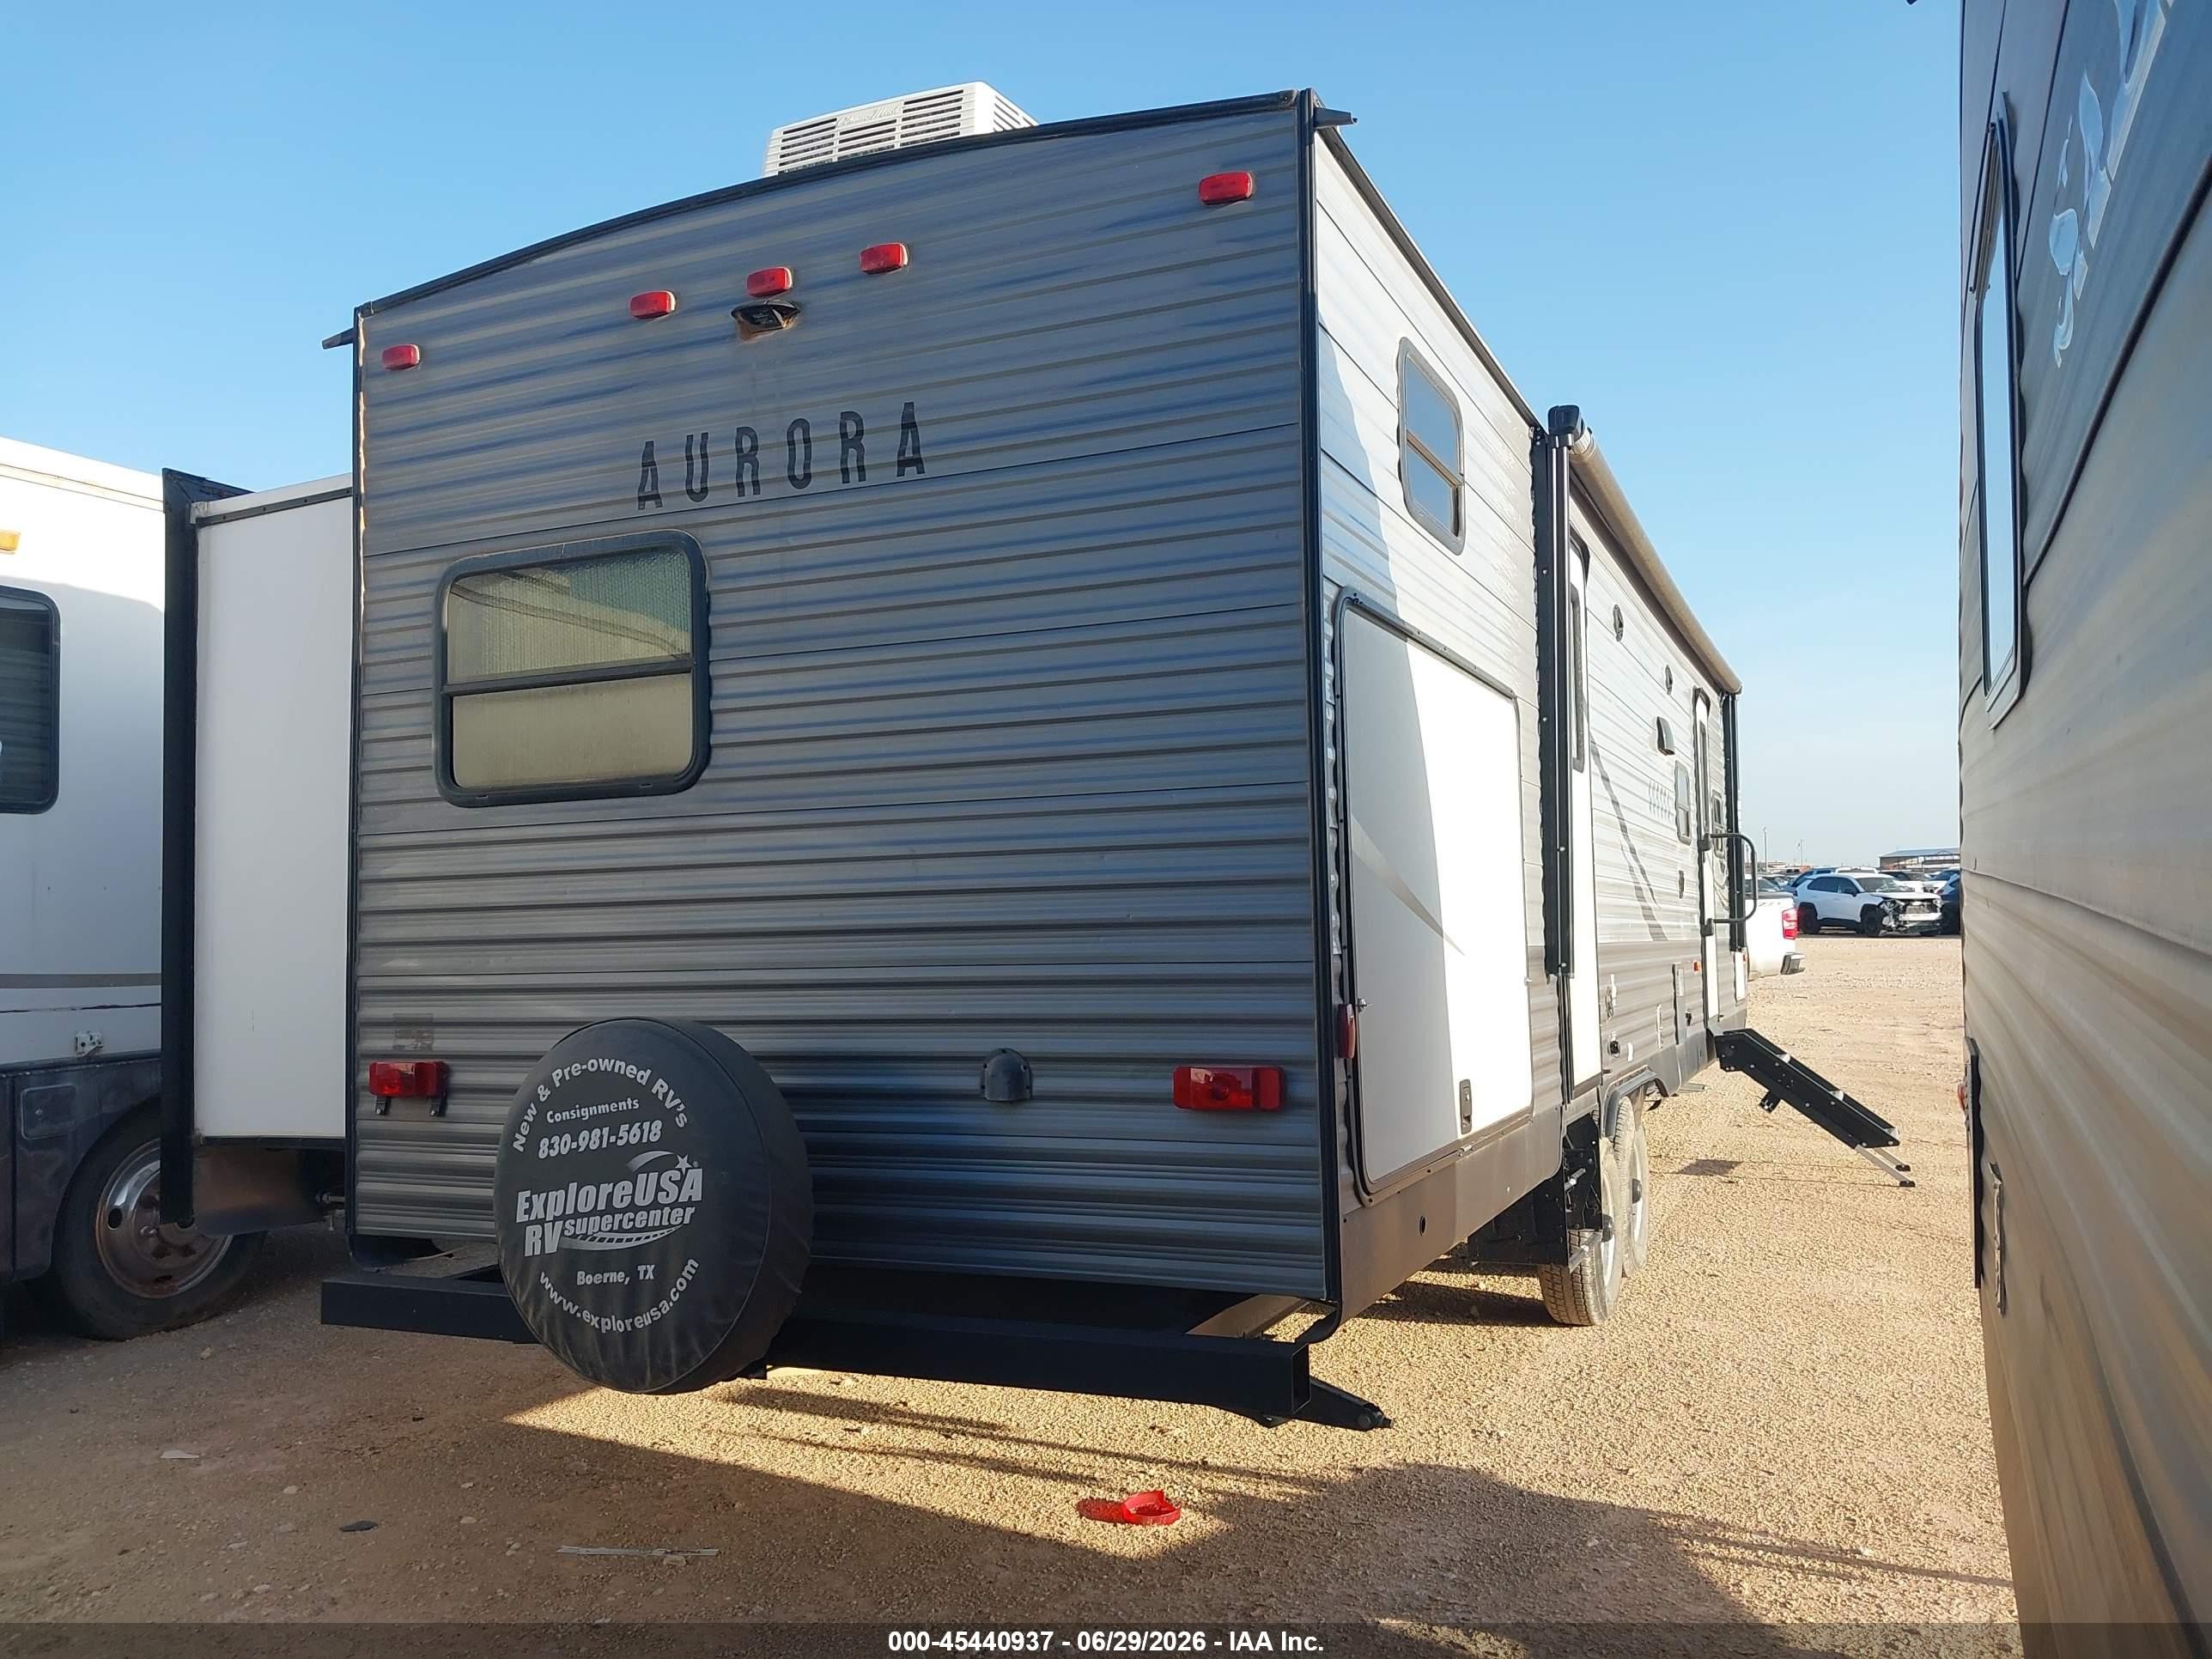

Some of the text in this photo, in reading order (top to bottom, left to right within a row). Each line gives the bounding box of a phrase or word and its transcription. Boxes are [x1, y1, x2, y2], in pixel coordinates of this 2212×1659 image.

[637, 402, 926, 510] AURORA
[513, 1059, 687, 1152] New & Pre-owned RV's
[547, 1097, 640, 1123] Consignments
[538, 1120, 663, 1159] 830-981-5618
[516, 1168, 703, 1223] ExploreUSA
[525, 1206, 696, 1257] RV supercenter
[540, 1258, 699, 1333] www.exploreusa.com
[576, 1264, 656, 1285] Boerne, TX
